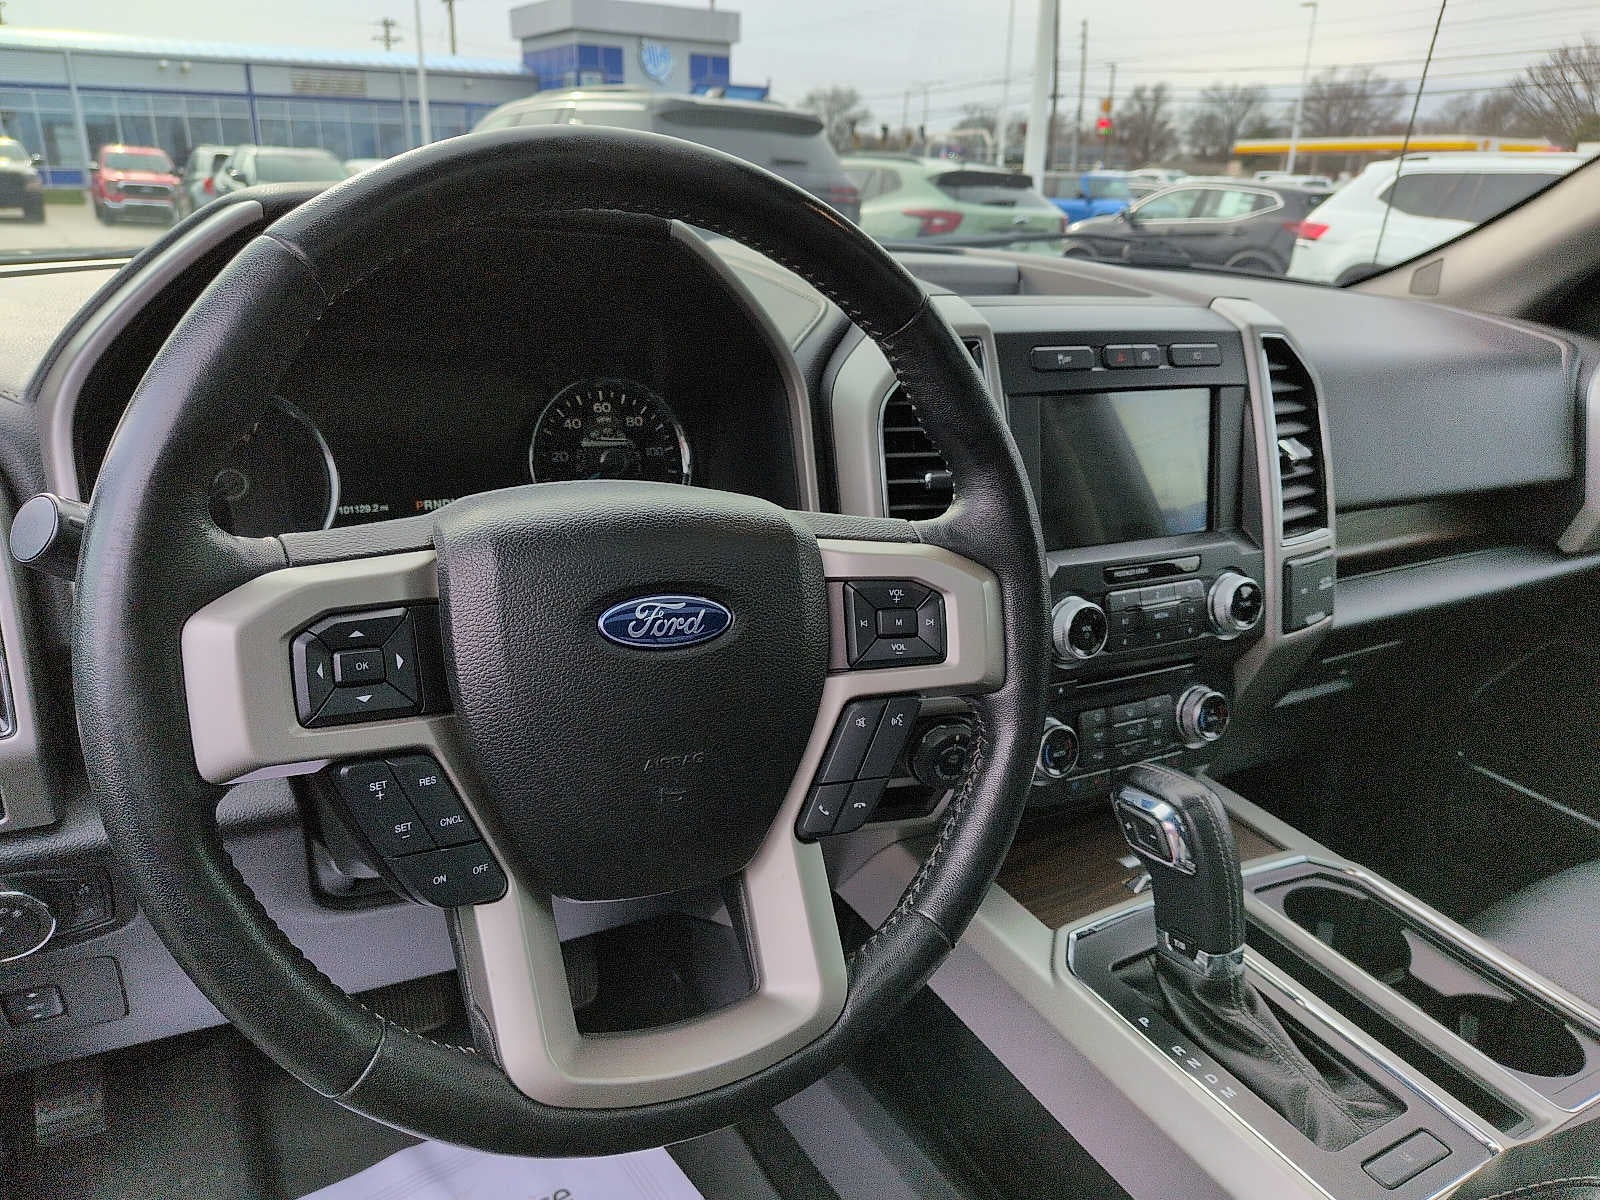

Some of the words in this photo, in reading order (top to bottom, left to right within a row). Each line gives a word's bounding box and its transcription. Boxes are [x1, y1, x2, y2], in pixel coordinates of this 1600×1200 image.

[593, 402, 611, 413] 60
[564, 418, 582, 429] 40
[626, 416, 643, 427] 80
[888, 589, 905, 597] VOL
[627, 601, 706, 638] Ford
[895, 618, 903, 626] M
[891, 643, 906, 651] VOL
[356, 661, 369, 671] OK
[369, 780, 388, 792] SET
[419, 776, 437, 787] RES
[440, 814, 464, 827] CNCL
[394, 821, 413, 834] SET
[472, 863, 490, 875] OFF
[432, 874, 447, 885] ON
[1138, 1016, 1150, 1028] P
[1171, 1045, 1187, 1057] R
[1186, 1057, 1202, 1069] N
[1204, 1073, 1218, 1084] D
[1220, 1086, 1238, 1099] M
